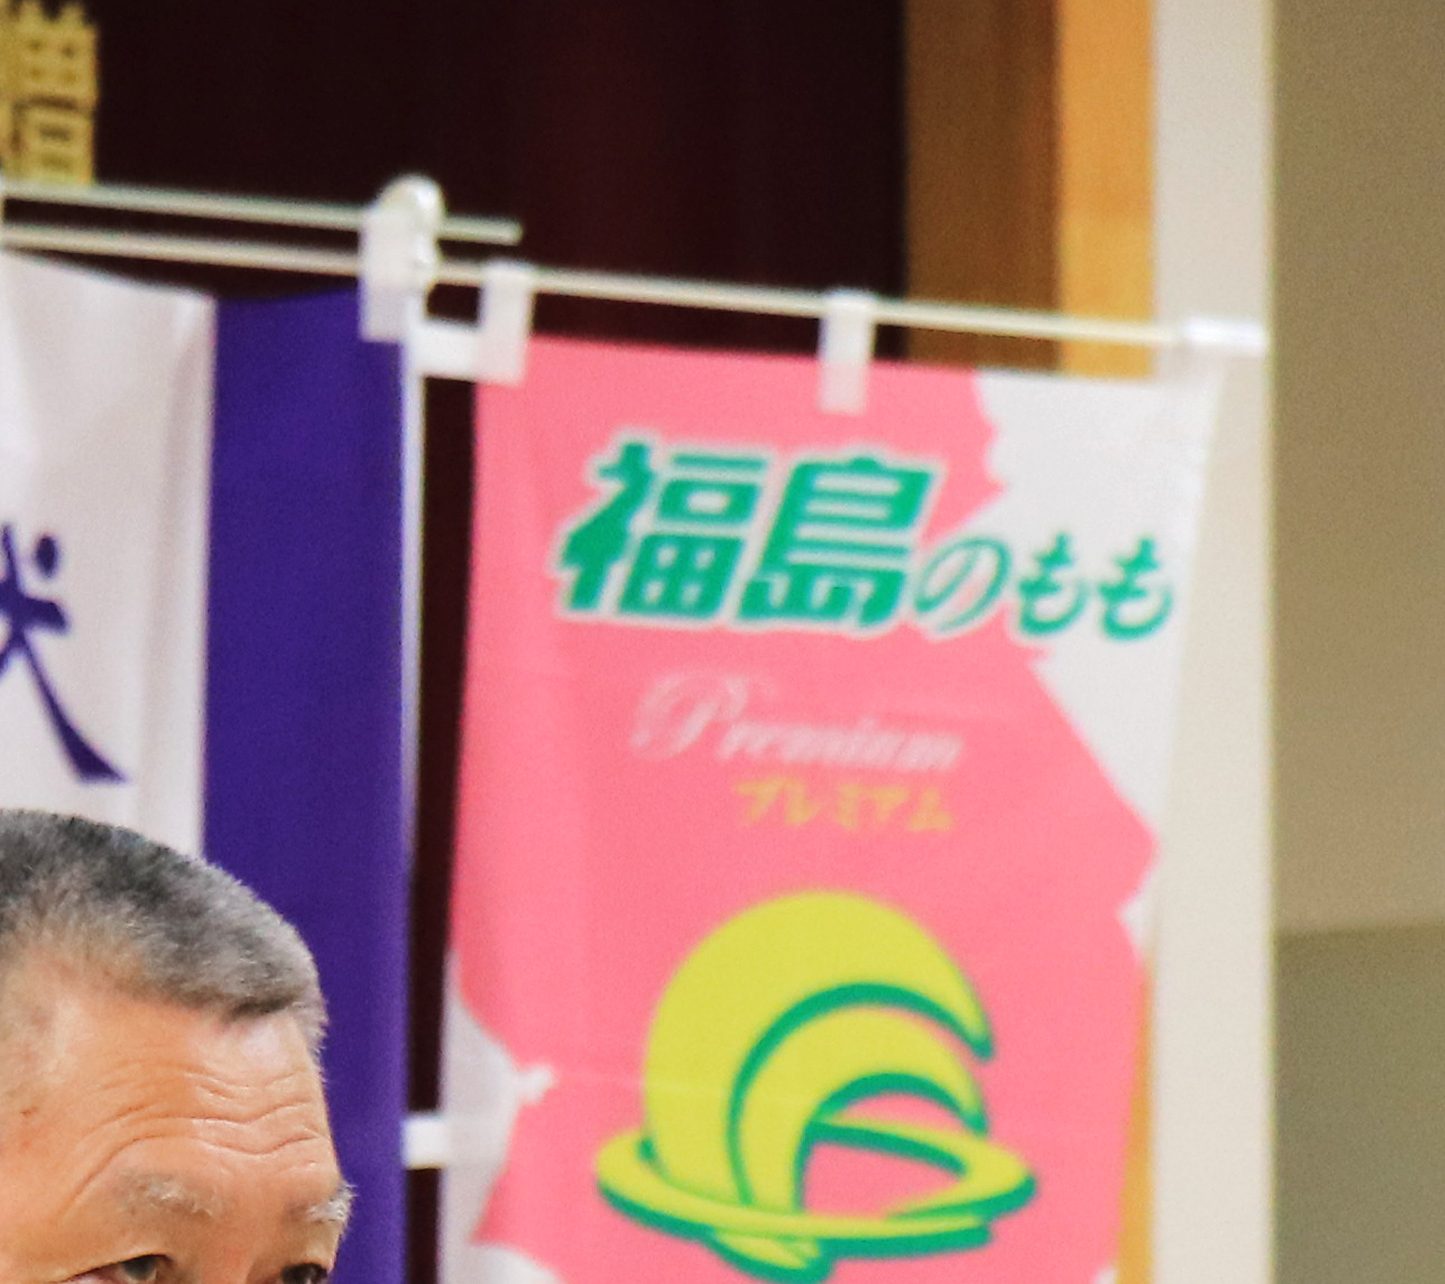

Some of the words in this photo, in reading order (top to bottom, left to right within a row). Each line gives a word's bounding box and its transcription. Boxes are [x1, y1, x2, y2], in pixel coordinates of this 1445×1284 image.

[557, 440, 1173, 642] 福島のもも
[627, 669, 965, 772] Premium
[733, 775, 954, 832] プレミアム
